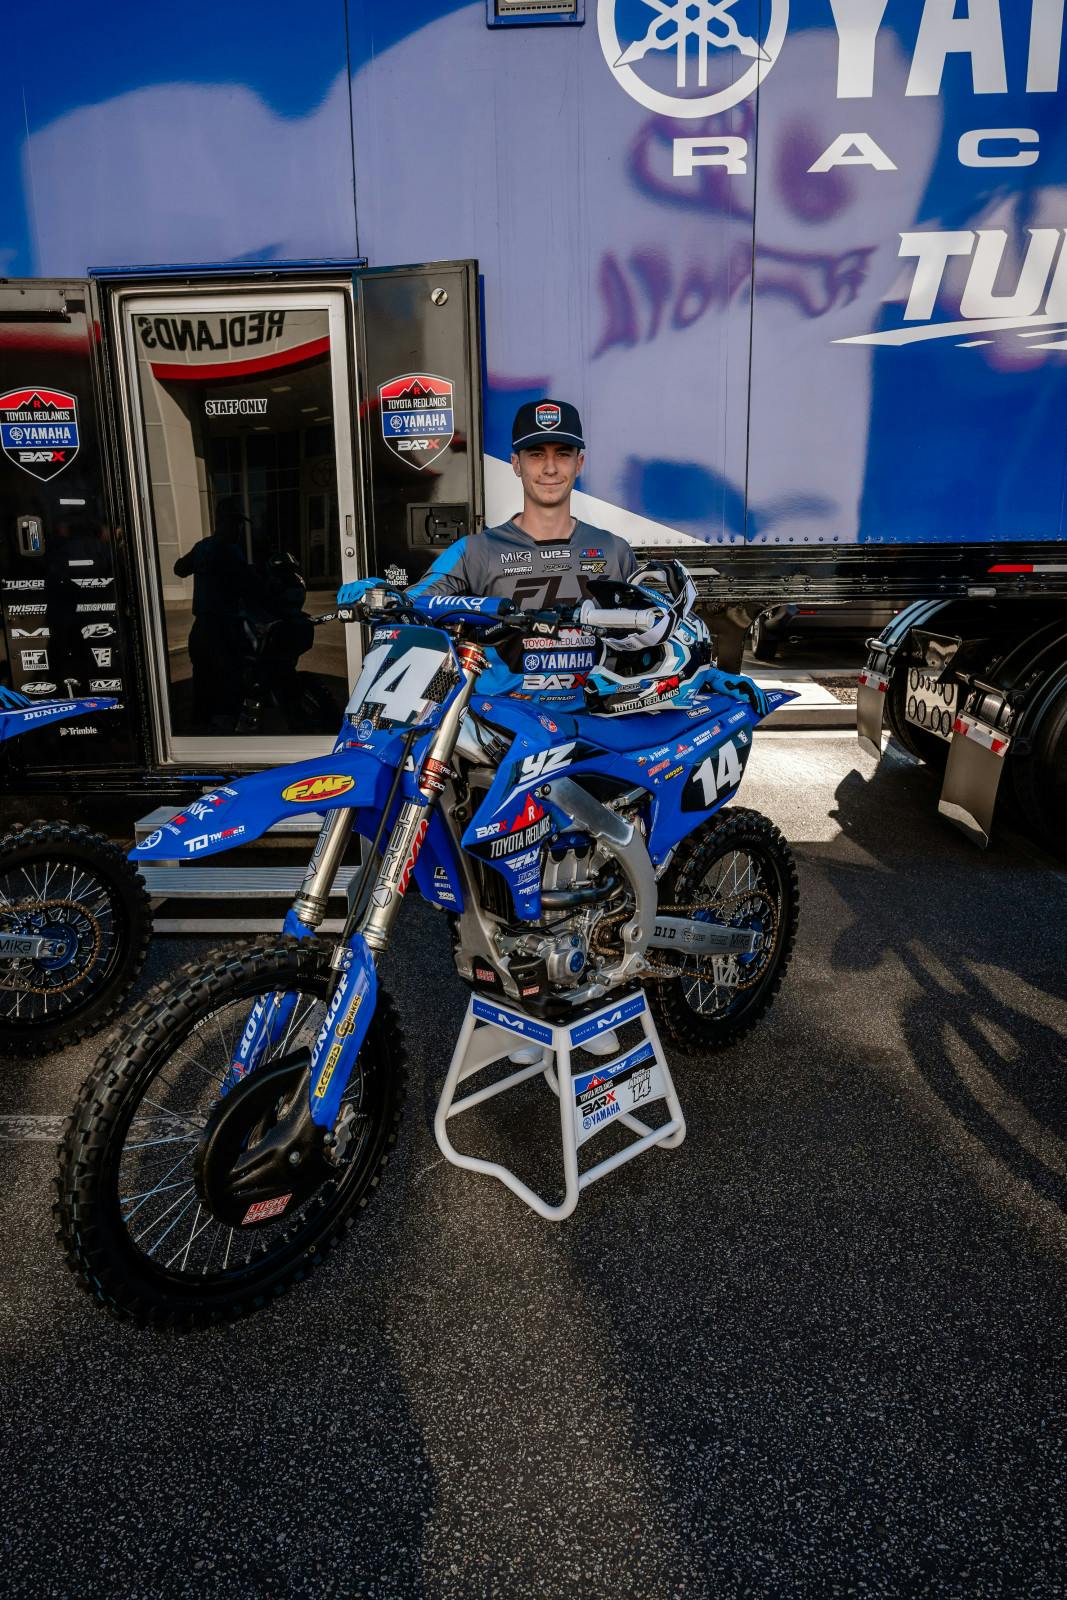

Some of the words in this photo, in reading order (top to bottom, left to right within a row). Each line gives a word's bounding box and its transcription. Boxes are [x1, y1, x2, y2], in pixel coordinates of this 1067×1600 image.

[897, 228, 1067, 321] TU
[205, 399, 239, 415] STAFF
[240, 398, 267, 414] ONLY
[388, 397, 412, 409] TOYOTA
[413, 396, 447, 408] REDLANDS
[5, 411, 33, 421] TOYOTA
[34, 410, 70, 421] REDLANDS
[402, 413, 447, 428] YAMAHA
[24, 426, 71, 440] YAMAHA
[6, 579, 45, 588] TUCKER
[8, 604, 47, 612] TWISTED
[523, 637, 554, 649] TOYOTA
[556, 635, 596, 648] EDLANDS
[541, 652, 593, 669] YAMAHA
[344, 644, 448, 723] 14
[522, 671, 590, 690] BARX
[24, 704, 77, 721] DUNLOP
[613, 700, 643, 713] TOYOTA
[68, 727, 97, 735] Trimble
[518, 741, 577, 784] YZ
[692, 740, 743, 807] 14
[285, 776, 352, 801] FMF
[528, 805, 535, 821] R
[475, 820, 508, 838] BARX
[490, 831, 524, 858] TOYOTA
[524, 815, 551, 847] REDLANDS
[504, 846, 540, 870] FLY
[310, 973, 349, 1068] UNLOP
[633, 1078, 652, 1103] 14
[581, 1089, 616, 1118] BARX
[591, 1102, 621, 1126] YAMAHA
